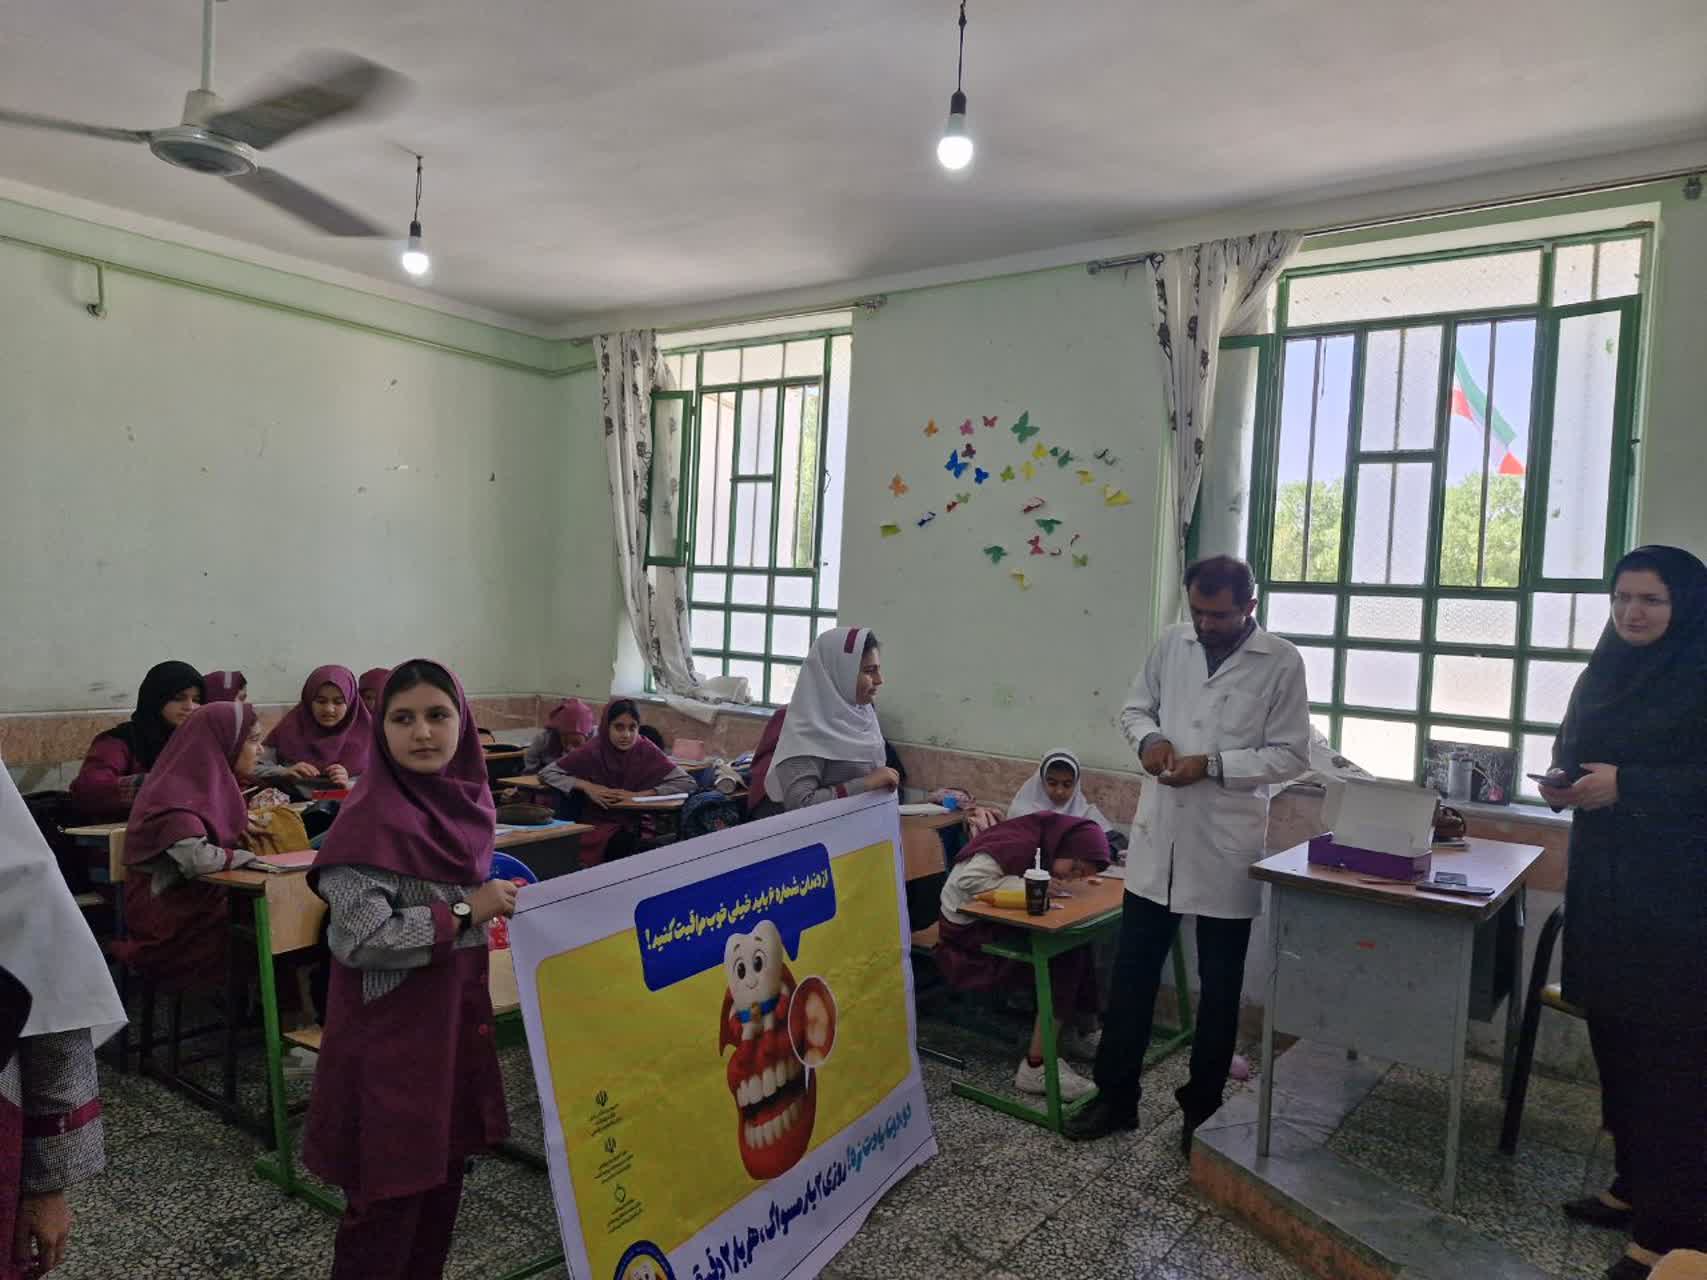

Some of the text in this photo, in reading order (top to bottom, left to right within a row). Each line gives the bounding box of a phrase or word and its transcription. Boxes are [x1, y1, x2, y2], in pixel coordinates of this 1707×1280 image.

[775, 875, 800, 904] شماره
[800, 872, 822, 896] دندان
[820, 868, 829, 888] از
[706, 902, 728, 932] خوب
[728, 893, 752, 924] خیلی
[751, 890, 769, 914] باید
[674, 909, 707, 941] مراقبت
[822, 1161, 847, 1197] روزی
[803, 1179, 817, 1215] بار
[732, 1235, 747, 1274] بار
[747, 1227, 760, 1264] هر
